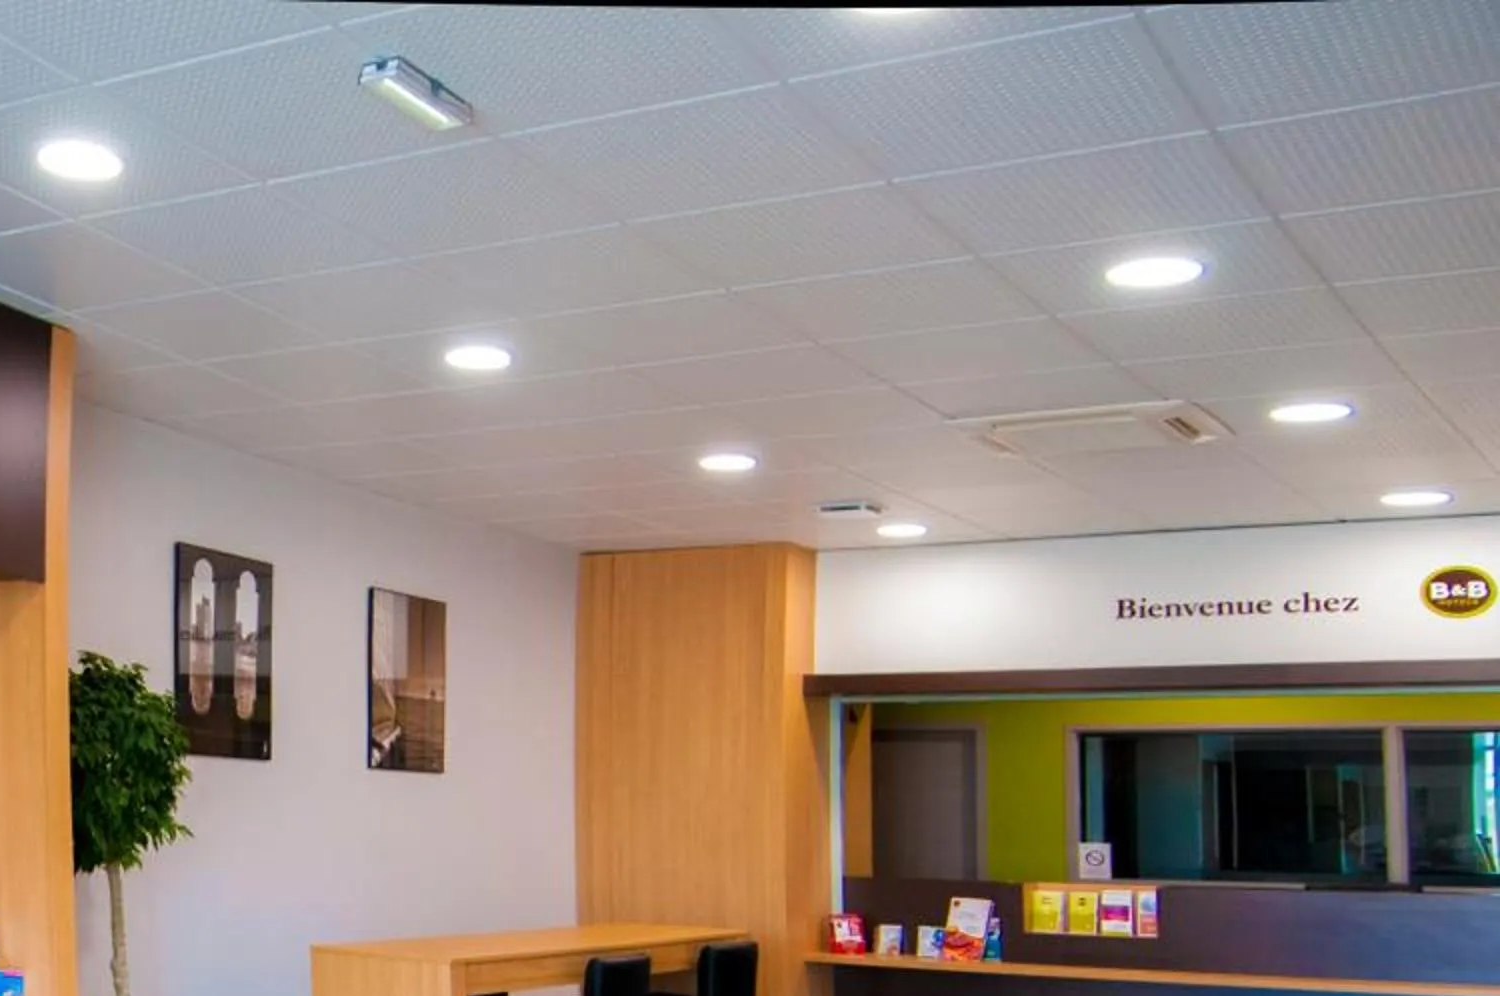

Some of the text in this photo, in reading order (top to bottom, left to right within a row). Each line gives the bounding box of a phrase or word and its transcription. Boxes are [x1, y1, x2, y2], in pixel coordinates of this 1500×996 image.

[1430, 580, 1488, 600] B&B
[1116, 591, 1360, 619] Bienvenue chez
